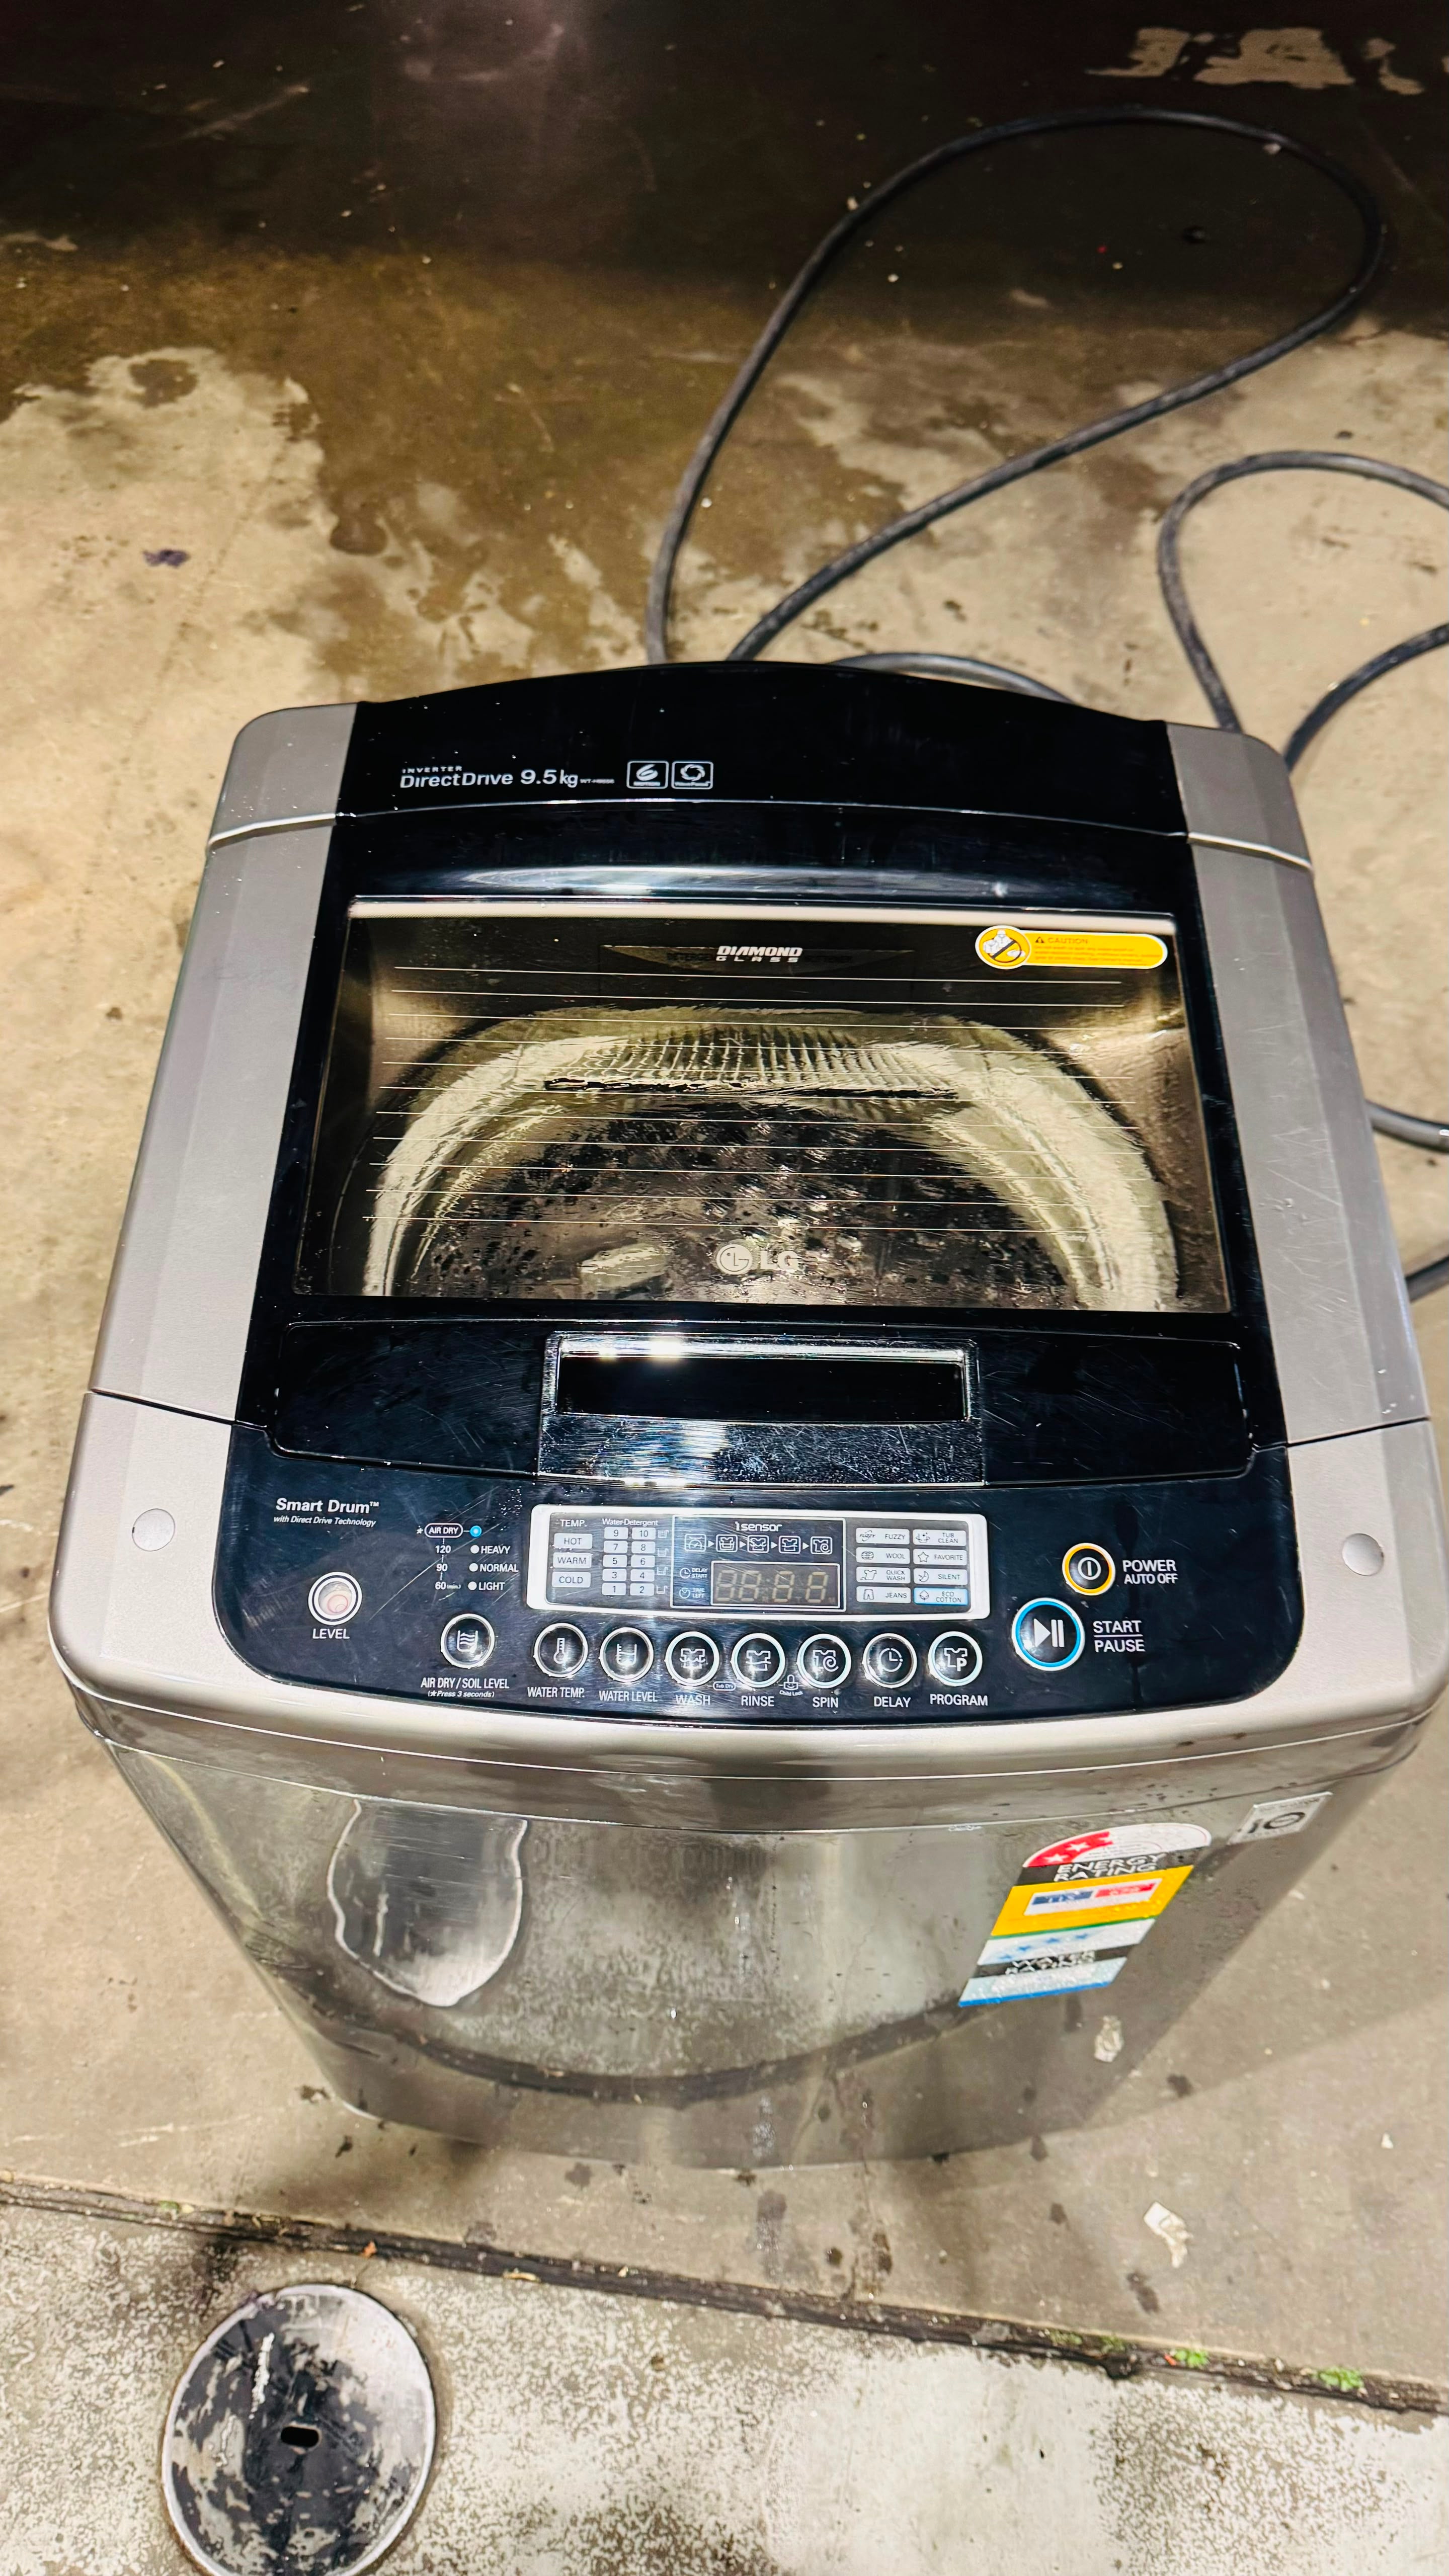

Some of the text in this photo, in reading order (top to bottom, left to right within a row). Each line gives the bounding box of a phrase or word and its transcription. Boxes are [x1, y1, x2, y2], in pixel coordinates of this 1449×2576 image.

[402, 765, 462, 774] INVERTER
[717, 946, 803, 956] DIAMOND
[760, 1250, 798, 1273] LG
[276, 1497, 323, 1512] Smart
[290, 1515, 311, 1523] Direct
[313, 1516, 332, 1524] Drive
[335, 1517, 376, 1527] Technology
[560, 1519, 587, 1527] TEMP.
[435, 1545, 451, 1553] 120
[481, 1546, 511, 1554] HEAVY
[436, 1564, 448, 1572] 90
[479, 1564, 519, 1572] NORMAL
[1122, 1560, 1177, 1572] POWER
[1124, 1573, 1178, 1584] AUTO OFF
[478, 1582, 505, 1590] LIGHT
[1093, 1620, 1142, 1634] START
[312, 1629, 350, 1639] LEVEL
[1094, 1640, 1146, 1653] PAUSE
[421, 1677, 435, 1688] AIR
[437, 1677, 455, 1688] DRY
[462, 1678, 481, 1689] SOIL
[484, 1678, 510, 1689] LEVEL
[527, 1687, 585, 1698] WATER TEMP.
[599, 1691, 658, 1702] WATER LEVEL
[676, 1695, 710, 1705] WASH
[741, 1696, 775, 1707] RINSE
[812, 1697, 839, 1708] SPIN
[874, 1697, 911, 1708] DELAY
[930, 1694, 988, 1706] PROGRAM
[1057, 1854, 1166, 1874] ENERGY
[1054, 1863, 1158, 1882] RATING
